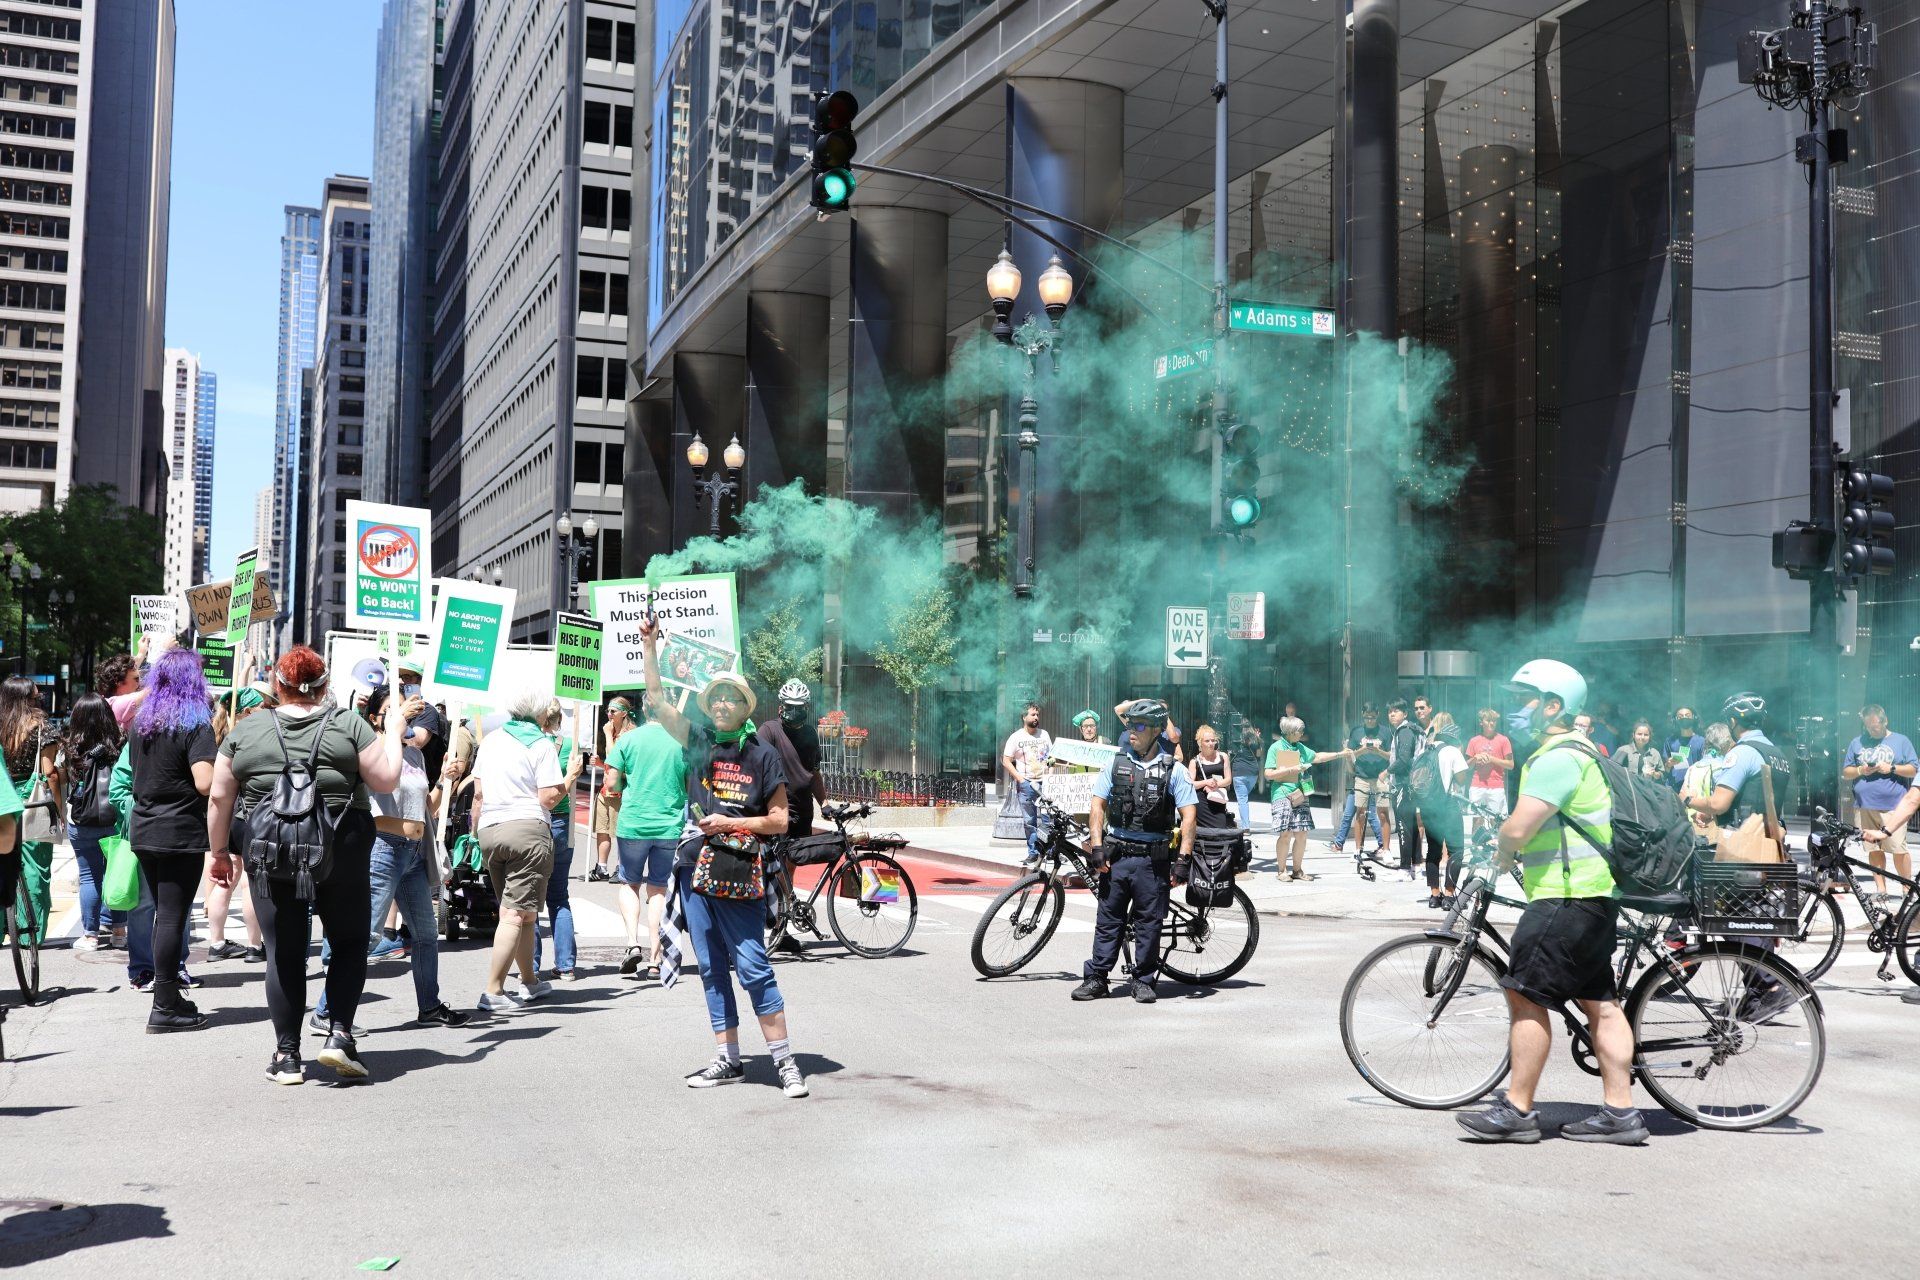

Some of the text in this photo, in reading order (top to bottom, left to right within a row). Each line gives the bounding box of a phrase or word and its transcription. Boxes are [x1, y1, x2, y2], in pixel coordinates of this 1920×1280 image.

[1234, 307, 1311, 328] W Adams St
[1172, 349, 1208, 371] Dearbrn
[193, 576, 269, 606] MIND UR
[360, 579, 419, 595] We WON'T
[143, 599, 163, 608] LOVE
[362, 595, 415, 611] Go Back!
[618, 588, 708, 604] This Decision
[140, 611, 160, 620] WHO
[198, 607, 223, 626] OWN
[448, 611, 497, 624] NO ABORTION
[610, 604, 719, 622] Must ot Stand.
[1172, 612, 1204, 627] ONE
[1242, 614, 1256, 623] BUS
[461, 621, 481, 631] BANS
[1242, 623, 1259, 631] STOP
[452, 635, 485, 646] NOT NOW
[560, 632, 600, 651] RISE UP 4
[617, 626, 716, 645] Leg Ation
[1172, 629, 1204, 643] WAY
[450, 643, 485, 653] NOT EVER!
[558, 653, 599, 671] ABORTION
[203, 668, 225, 677] FEMALE
[561, 674, 594, 691] RIGHTS!
[1769, 755, 1790, 774] POLICE
[1047, 775, 1067, 785] GOD
[1073, 859, 1095, 888] CHICAGO
[1194, 877, 1230, 891] POLICE
[1849, 873, 1866, 901] CHICAGO
